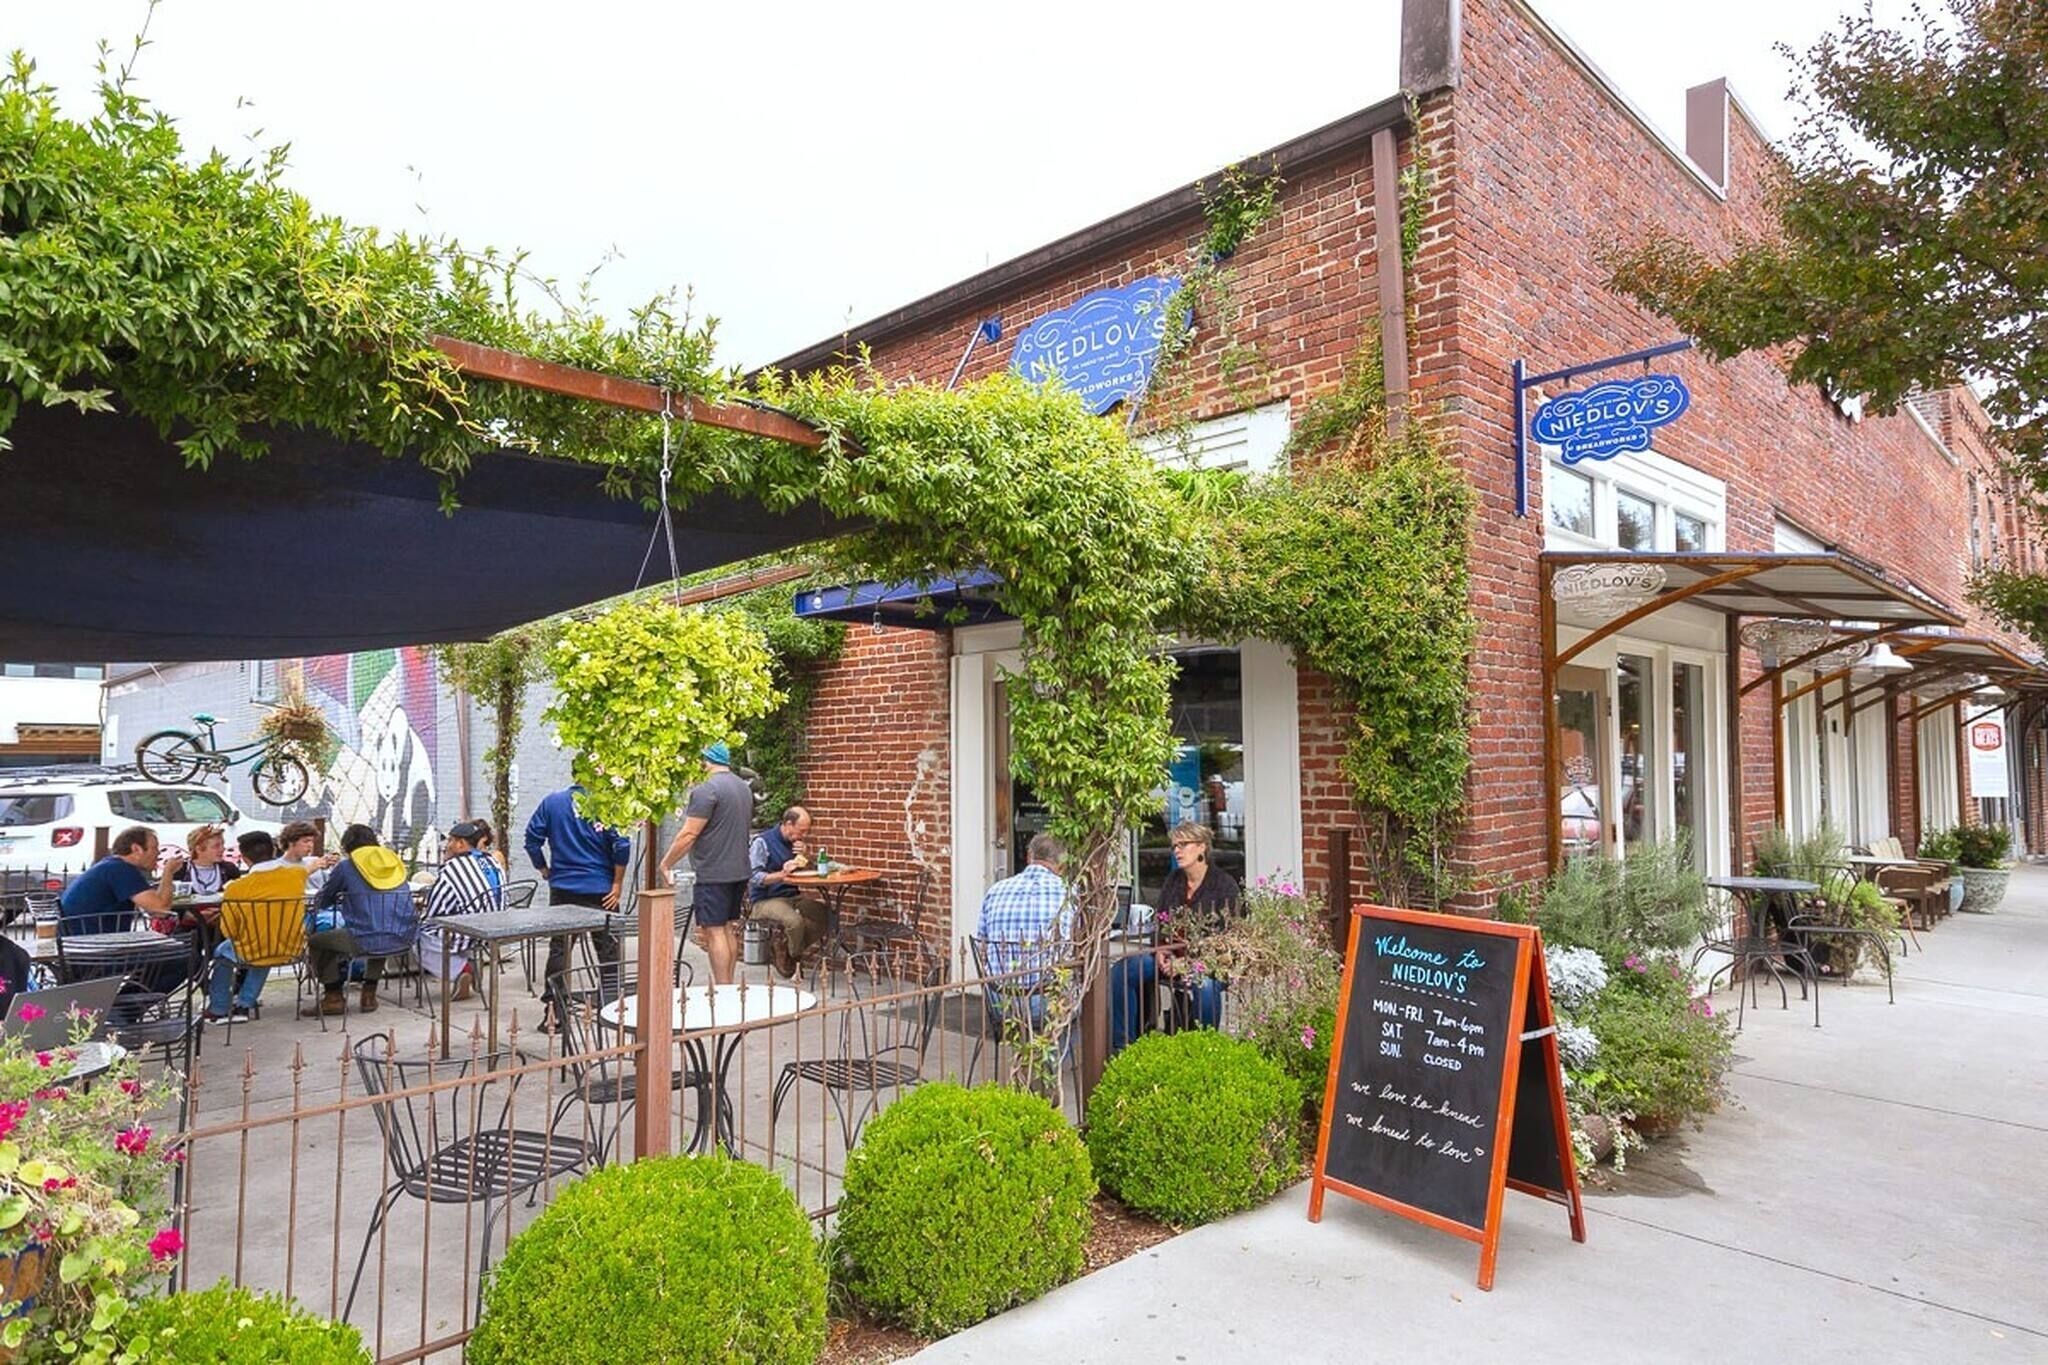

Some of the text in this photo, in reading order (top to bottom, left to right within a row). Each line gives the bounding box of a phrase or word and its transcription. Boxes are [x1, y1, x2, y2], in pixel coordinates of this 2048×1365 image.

[1551, 399, 1670, 436] NIEDLOV'S
[1563, 575, 1652, 595] NIEDLOV'S
[1375, 936, 1486, 969] Welcome to
[1392, 963, 1468, 994] NIEDLOV'S
[1423, 1053, 1462, 1071] CLOSED
[1351, 1081, 1485, 1128] we love to knead
[1345, 1113, 1363, 1128] we
[1415, 1132, 1436, 1148] to
[1439, 1140, 1472, 1163] love
